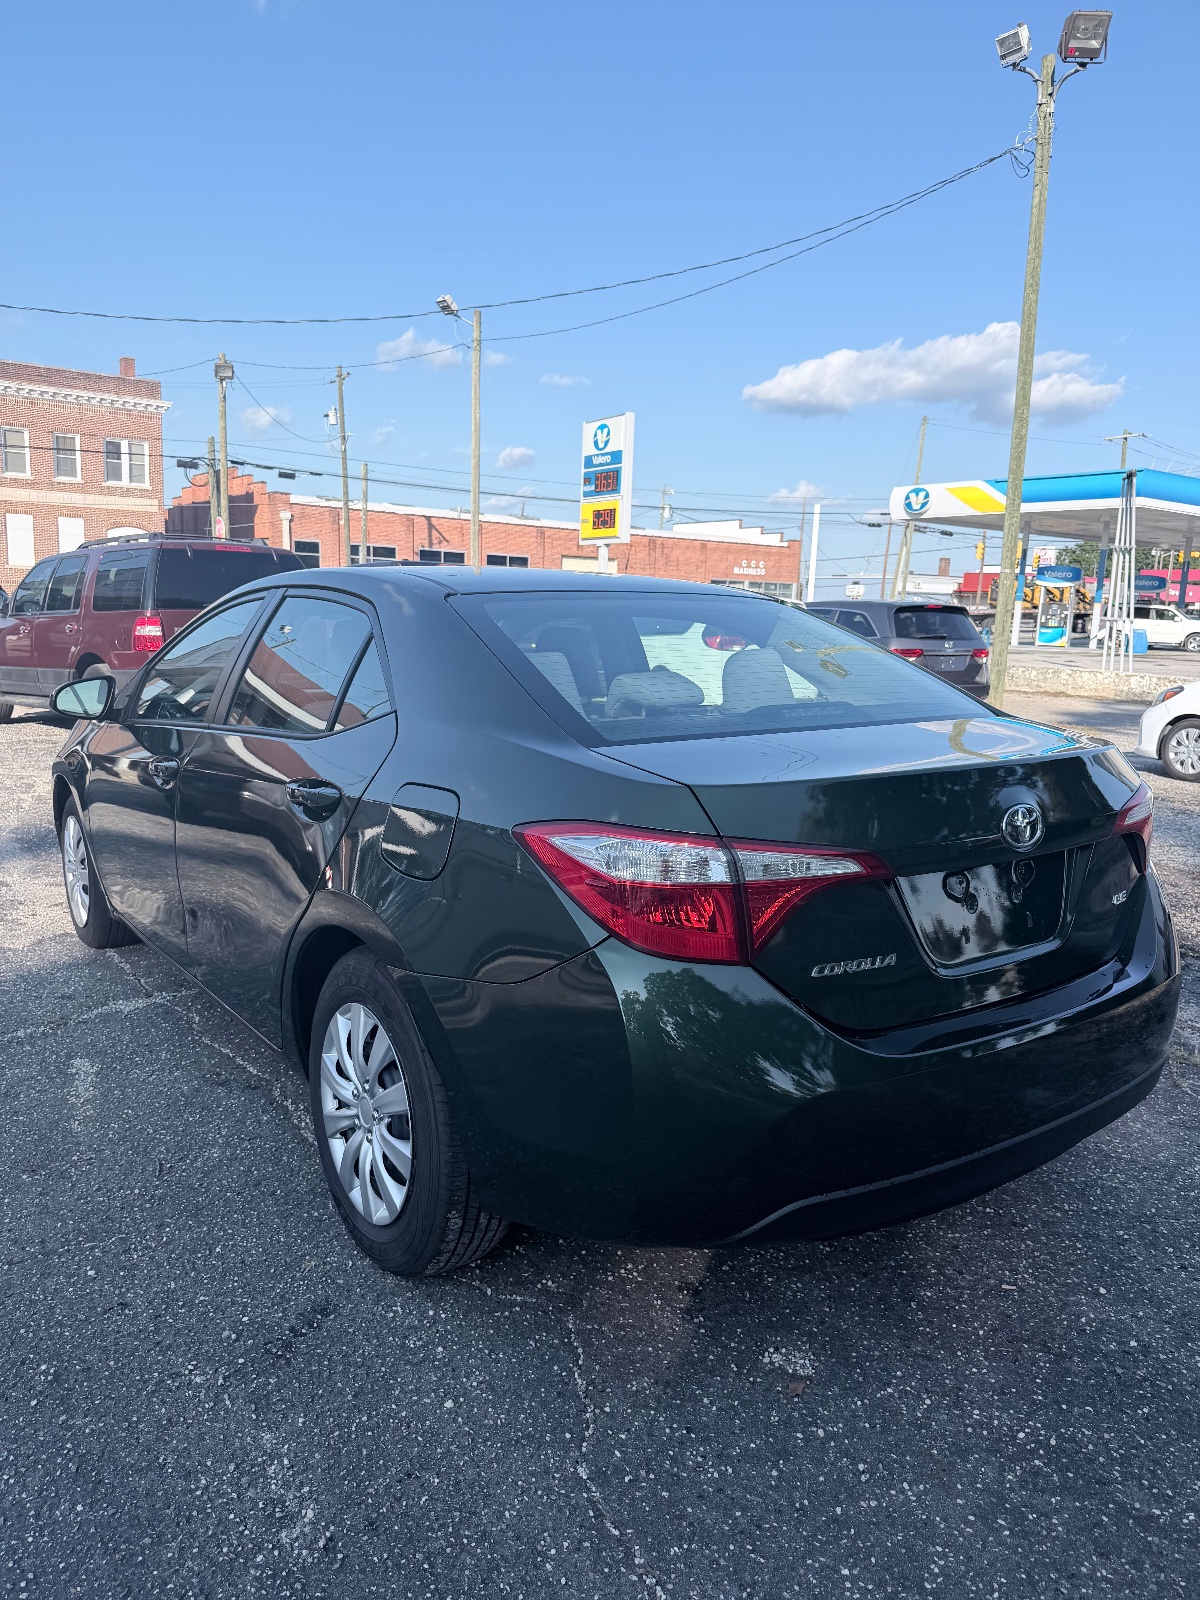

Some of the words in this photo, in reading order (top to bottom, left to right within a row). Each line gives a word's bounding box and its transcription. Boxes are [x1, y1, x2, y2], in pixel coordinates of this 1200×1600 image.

[591, 454, 612, 465] Valero
[1044, 570, 1073, 578] Valero
[811, 953, 897, 978] COROLLA
